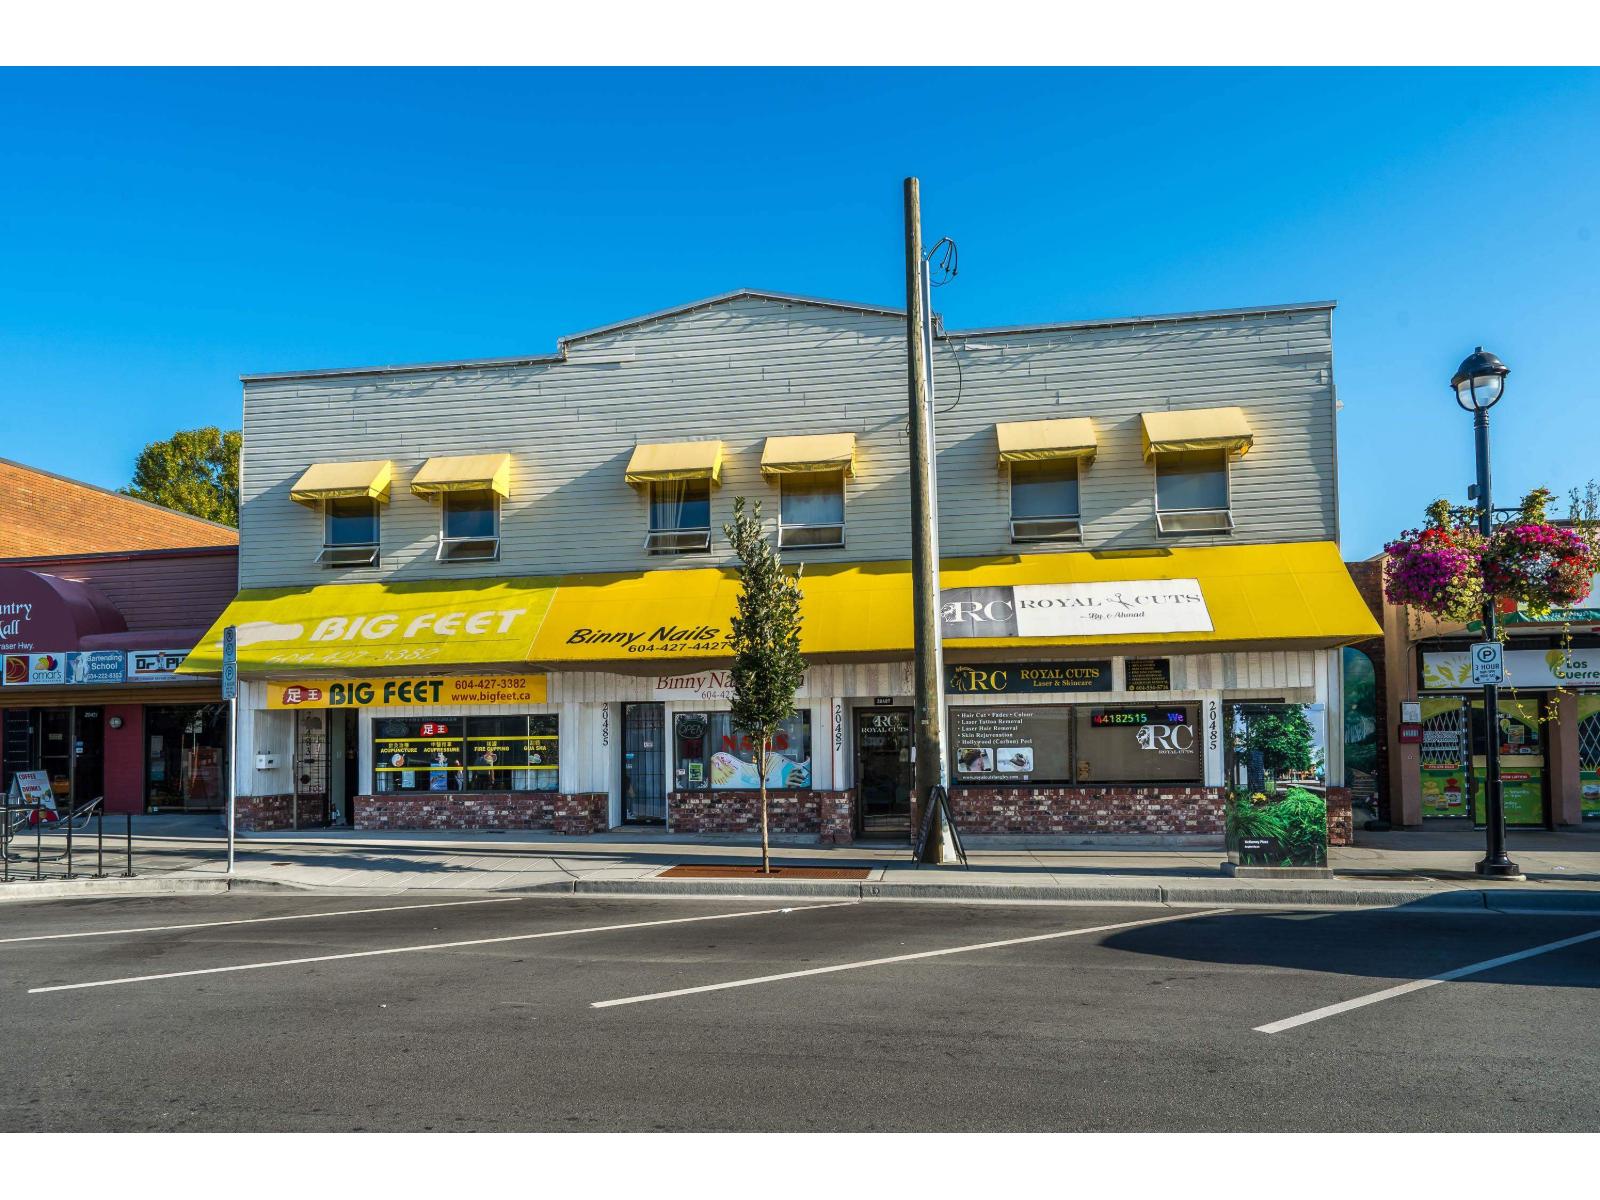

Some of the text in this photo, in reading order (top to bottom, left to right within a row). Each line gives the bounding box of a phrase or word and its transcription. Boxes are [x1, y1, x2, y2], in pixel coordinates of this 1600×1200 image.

[1021, 593, 1200, 609] ROYAL CUTS
[956, 600, 1013, 622] RC
[308, 609, 526, 641] BIG FEET
[566, 628, 646, 647] Binny
[647, 626, 720, 642] Nails
[628, 642, 728, 652] 604-427-4427
[1482, 650, 1492, 660] P
[92, 662, 118, 670] School
[136, 658, 156, 669] Dr
[1566, 658, 1588, 668] Los
[33, 670, 62, 680] omar's
[1021, 668, 1100, 680] ROYAL CUTS
[455, 678, 526, 690] 604-427-3382
[656, 675, 705, 692] Binny
[969, 670, 1008, 691] RC
[287, 688, 319, 703] 足王
[330, 681, 444, 706] BIG FEET
[452, 692, 530, 702] www.bigfeet.ca
[1168, 713, 1184, 722] We
[1144, 725, 1194, 750] RC
